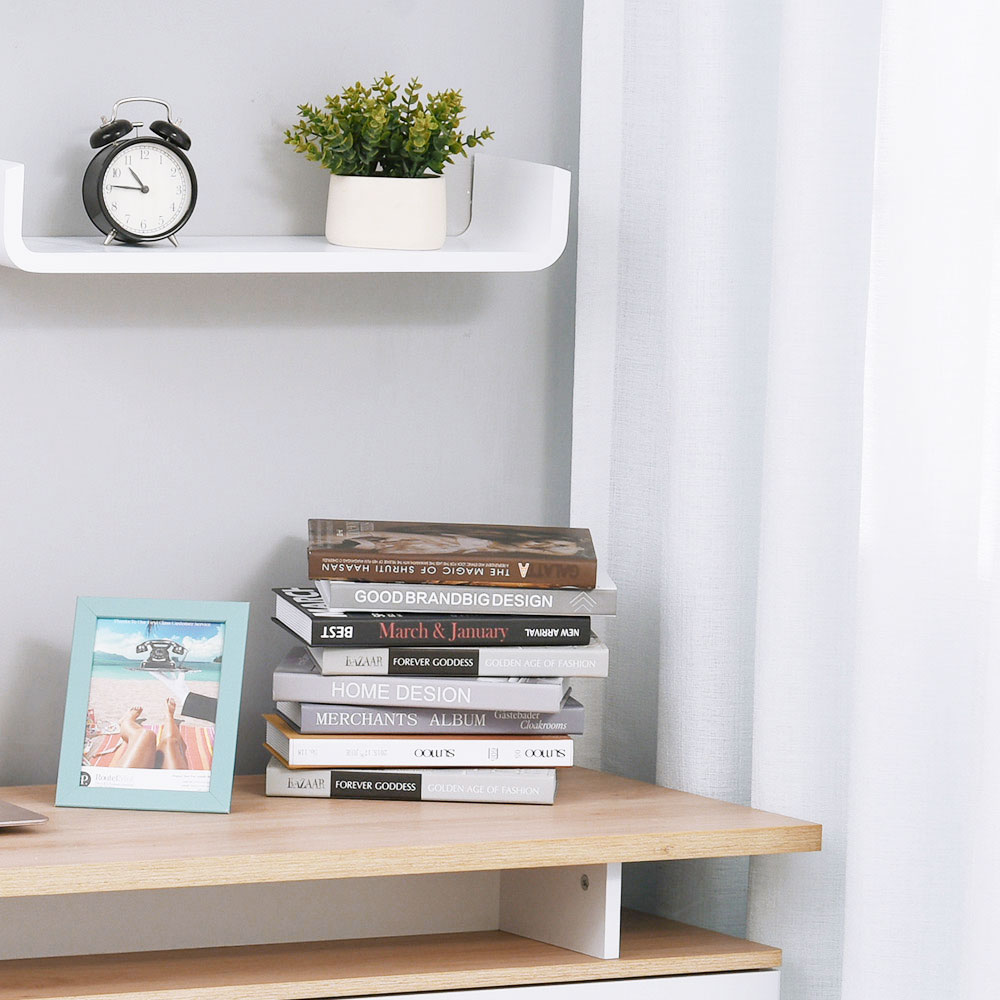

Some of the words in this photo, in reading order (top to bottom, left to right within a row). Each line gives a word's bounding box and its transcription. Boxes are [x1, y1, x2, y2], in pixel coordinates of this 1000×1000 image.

[140, 149, 150, 160] 12
[125, 155, 132, 165] 11
[170, 168, 177, 178] 2
[105, 184, 113, 194] 9
[140, 220, 147, 229] 6
[321, 562, 370, 572] HAASAN
[375, 564, 415, 574] SHRUTI
[420, 566, 437, 574] OF
[442, 566, 484, 576] MAGIC
[490, 568, 510, 577] THE
[321, 626, 354, 639] BEST
[379, 622, 430, 639] March
[432, 622, 446, 639] &
[448, 623, 509, 643] January
[525, 628, 559, 637] ARRIVAL
[560, 628, 580, 637] NEW
[393, 657, 430, 667] FOREVER
[432, 657, 474, 668] GODDESS
[485, 657, 522, 667] GOLDEN
[524, 658, 541, 667] AGE
[543, 658, 556, 668] OF
[558, 658, 596, 669] FASHION
[331, 681, 390, 700] HOME
[396, 683, 471, 703] DESIGN
[315, 712, 418, 727] MERCHANTS
[429, 712, 486, 727] ALBUM
[519, 720, 567, 730] Cloakrooms
[335, 780, 373, 790] FOREVER
[375, 781, 417, 792] GODDESS
[427, 783, 465, 794] GOLDEN
[467, 784, 485, 794] AGE
[487, 785, 500, 795] OF
[501, 785, 540, 796] FASHION
